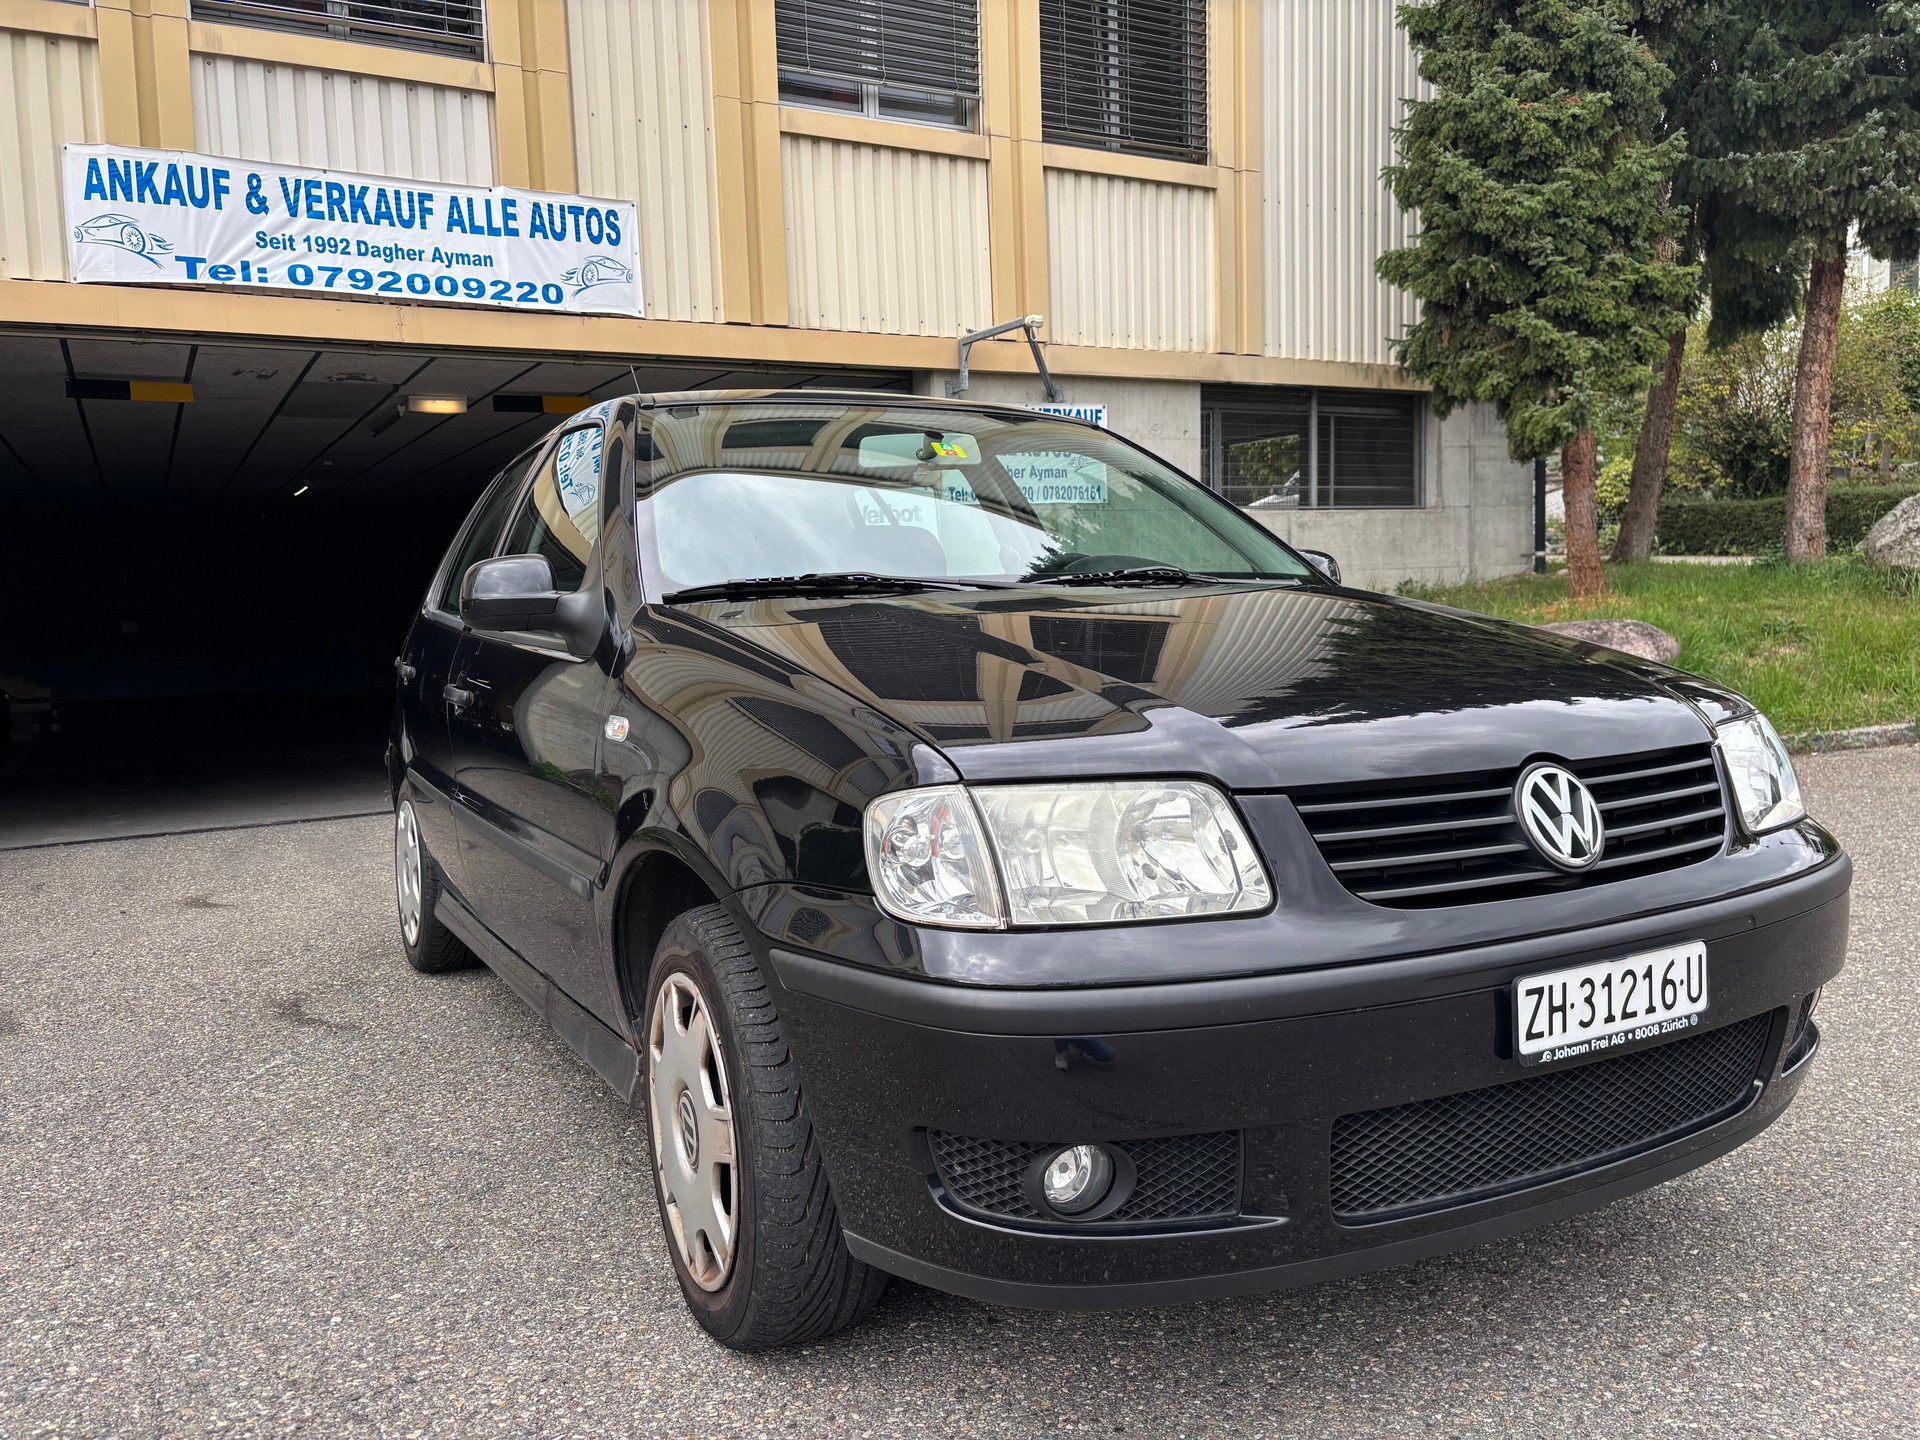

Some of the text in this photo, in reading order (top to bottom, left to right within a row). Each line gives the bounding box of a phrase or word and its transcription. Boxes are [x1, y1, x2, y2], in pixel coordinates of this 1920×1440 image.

[84, 157, 622, 246] ANKAUF & VERKAUF ALLE AUTOS
[255, 230, 494, 268] Seit 1992 Dagher Ayman
[175, 255, 564, 304] Tel: 0792009220
[948, 486, 968, 501] Tel:
[1043, 485, 1101, 501] 0782076161
[1029, 464, 1068, 481] Ayman
[1553, 1017, 1689, 1061] Johann Frei AG 8008 Zürich
